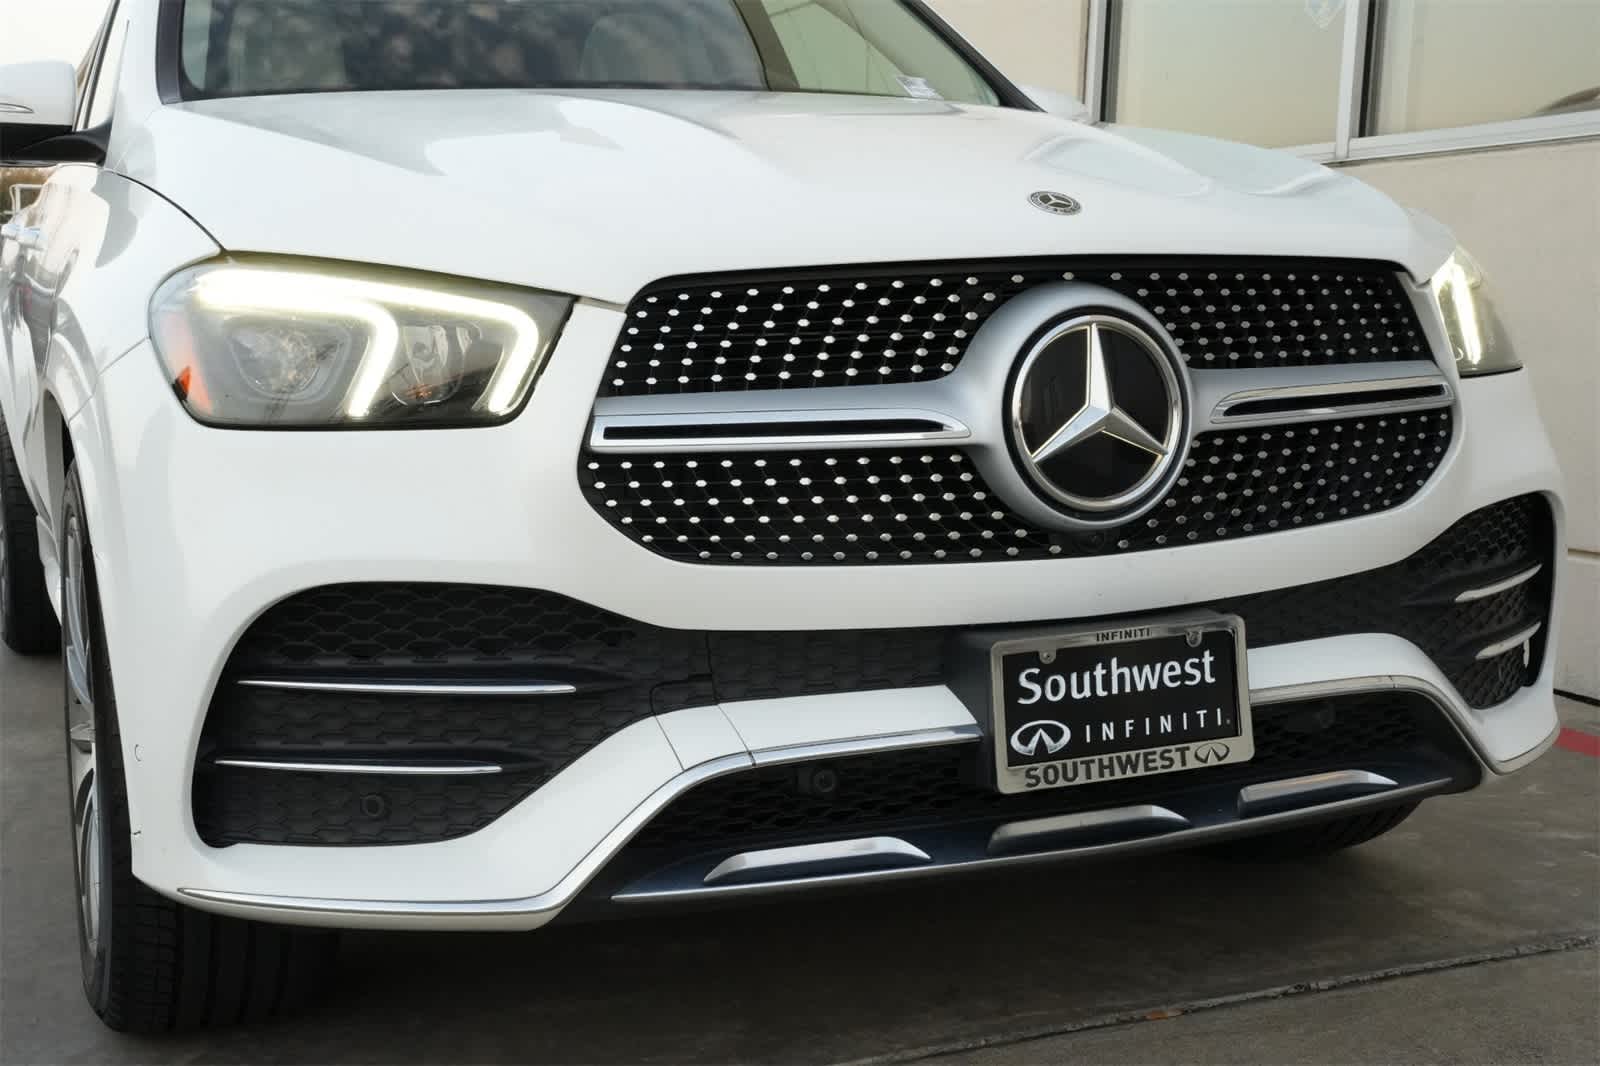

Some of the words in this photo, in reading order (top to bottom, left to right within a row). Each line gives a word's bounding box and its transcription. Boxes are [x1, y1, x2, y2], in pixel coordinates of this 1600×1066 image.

[1096, 627, 1151, 642] INFINITI
[1017, 649, 1216, 705] Southwest
[1085, 707, 1222, 743] INFINITI
[1024, 746, 1191, 788] SOUTHWEST
